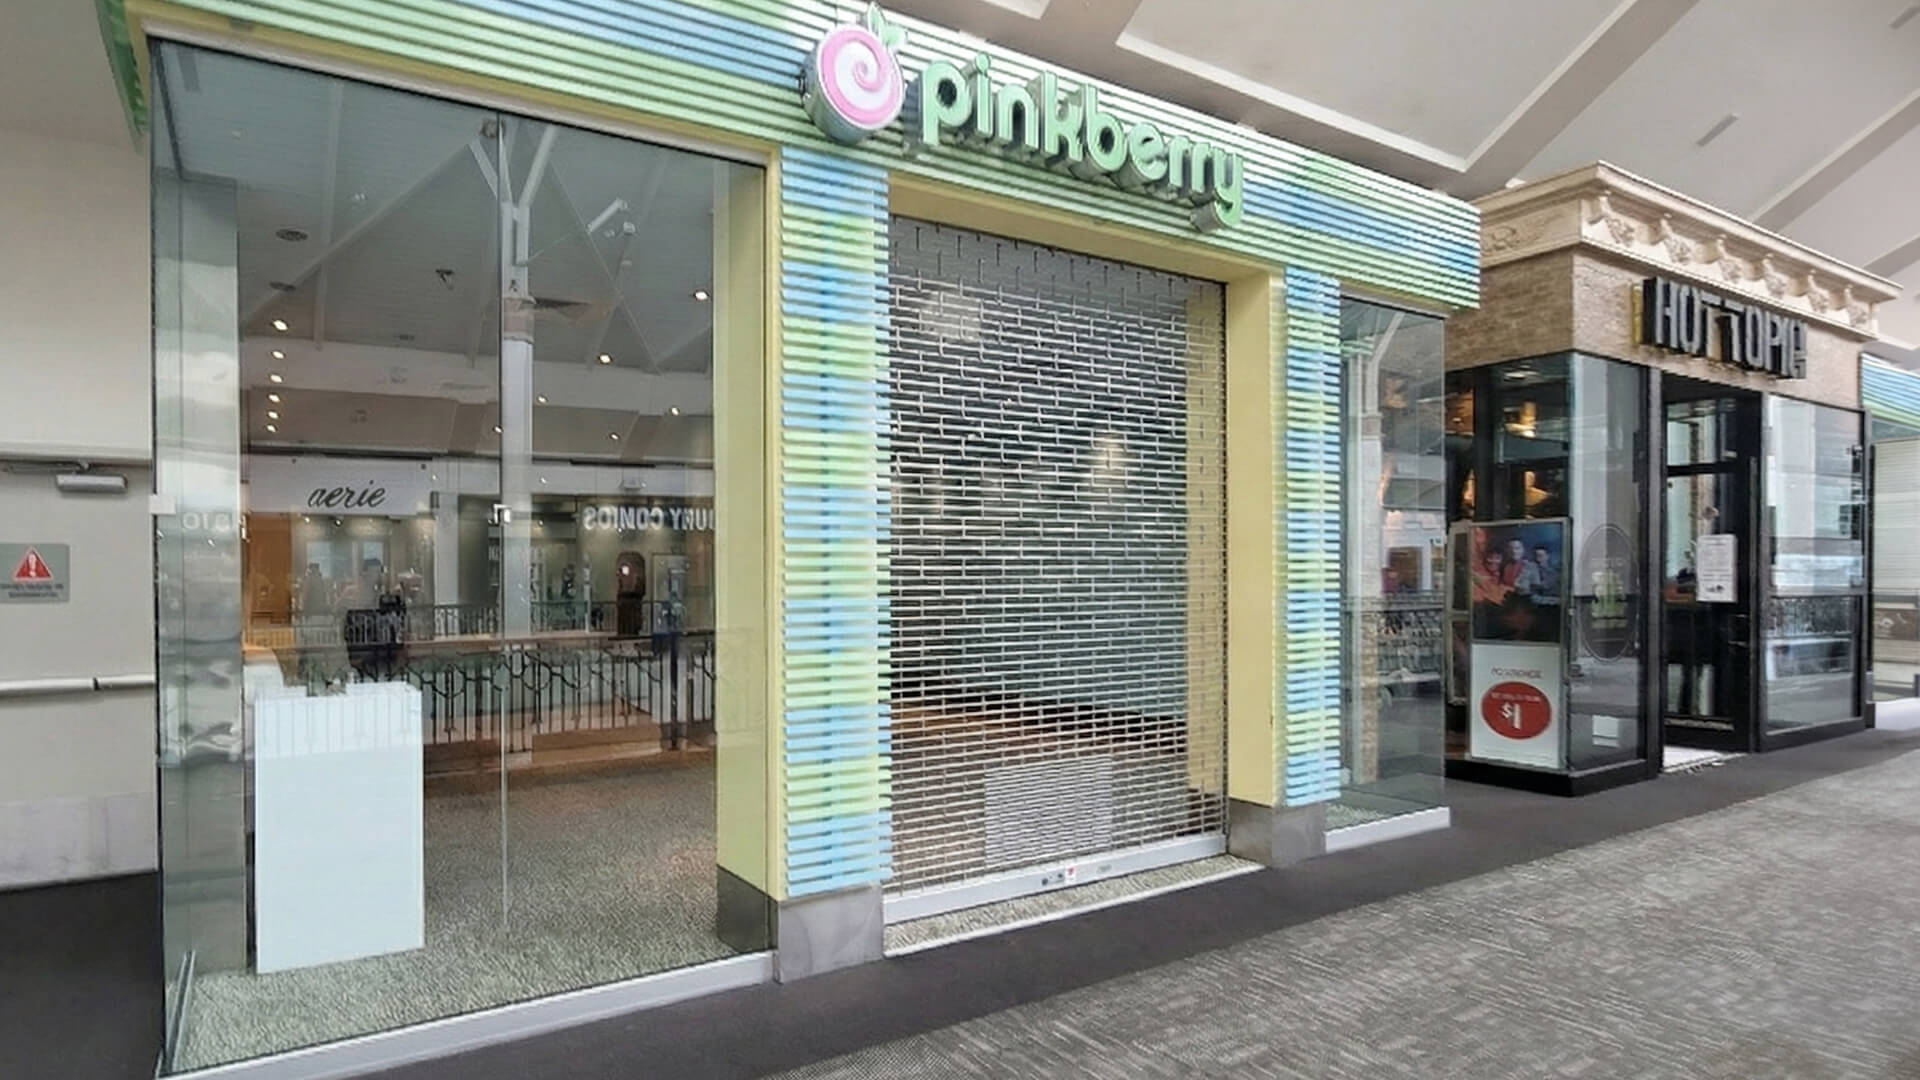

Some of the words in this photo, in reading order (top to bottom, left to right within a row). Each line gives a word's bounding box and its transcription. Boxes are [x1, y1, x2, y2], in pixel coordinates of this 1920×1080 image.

[920, 51, 1244, 228] pinkberry
[1645, 276, 1720, 359] HOT
[1721, 298, 1808, 380] TOPIC
[307, 479, 386, 508] aerie
[1499, 701, 1522, 730] $1
